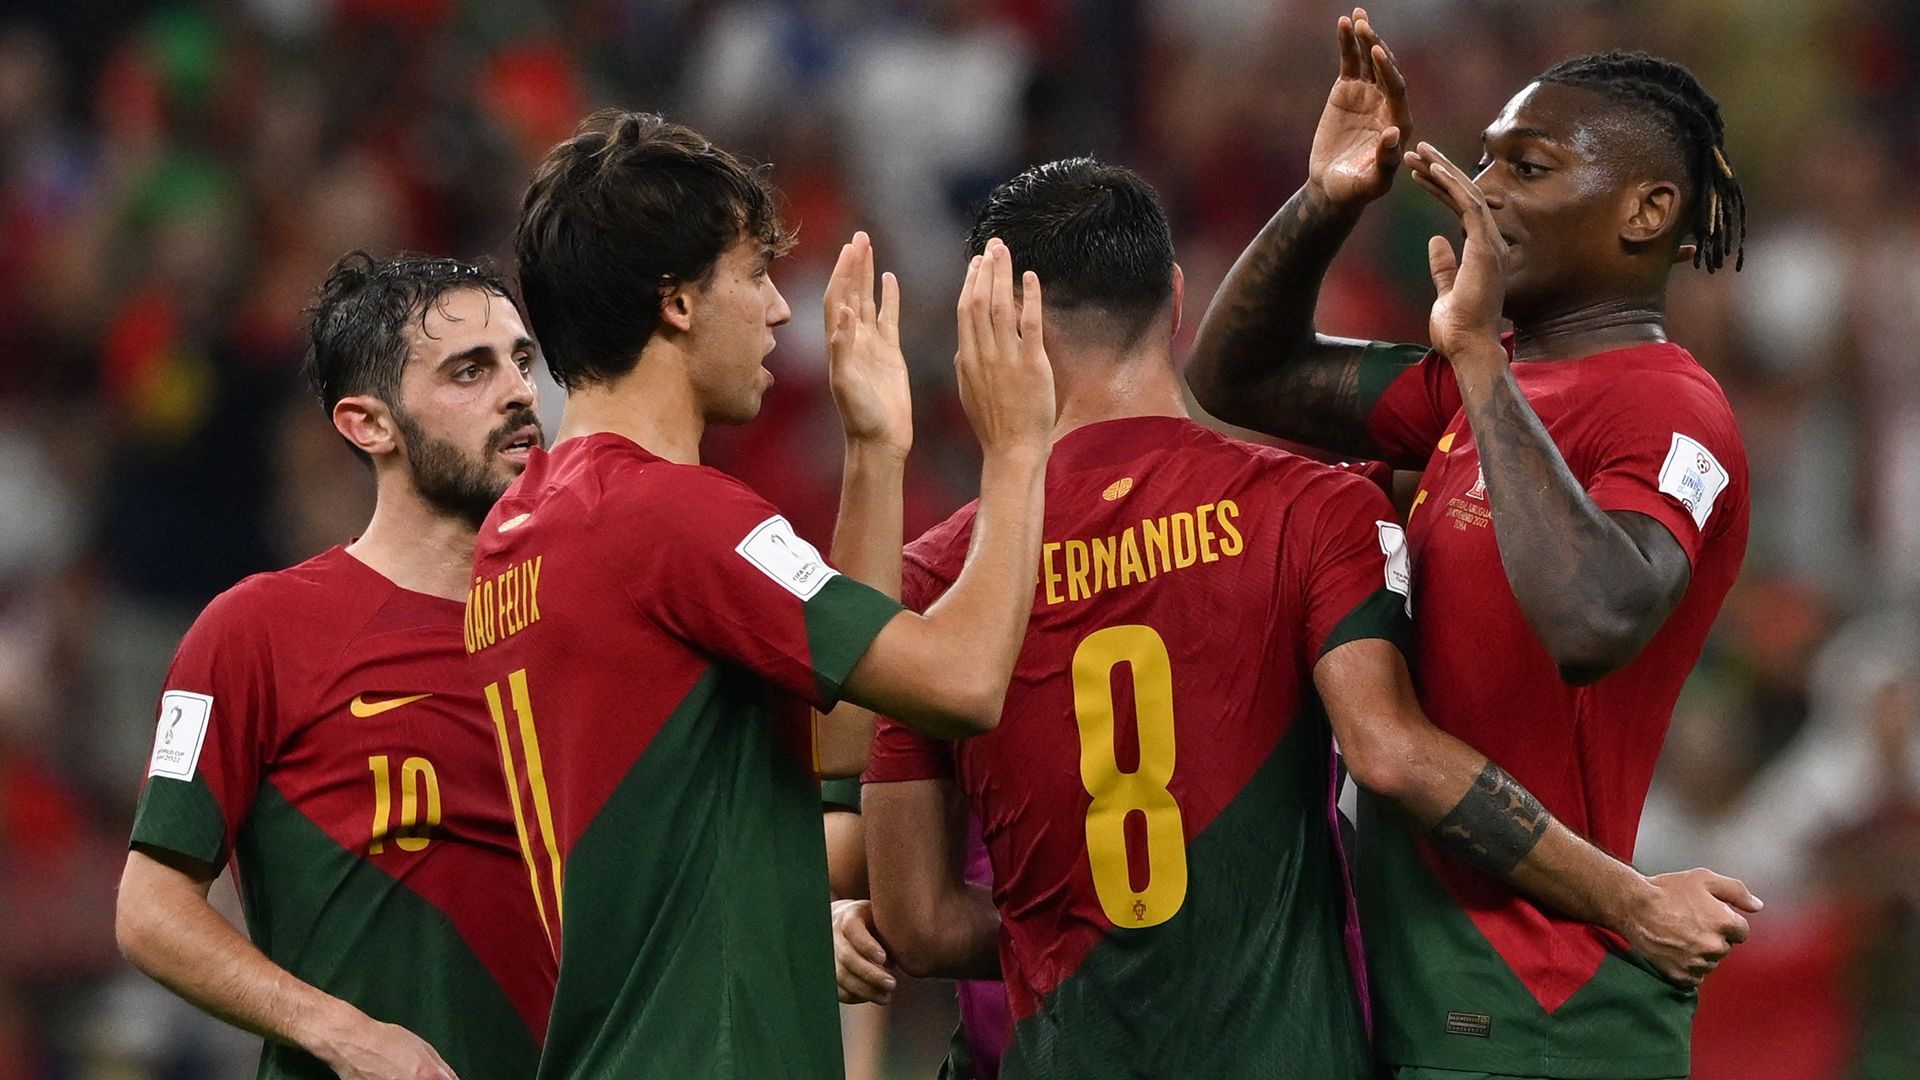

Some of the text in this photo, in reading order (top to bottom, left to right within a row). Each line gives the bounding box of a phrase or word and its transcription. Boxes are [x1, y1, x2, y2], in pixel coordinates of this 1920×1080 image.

[464, 555, 542, 655] OÃO FÉLIX
[1037, 499, 1244, 605] ERNANDES
[368, 755, 441, 855] 10
[484, 668, 563, 960] 11
[1072, 624, 1188, 929] 8
